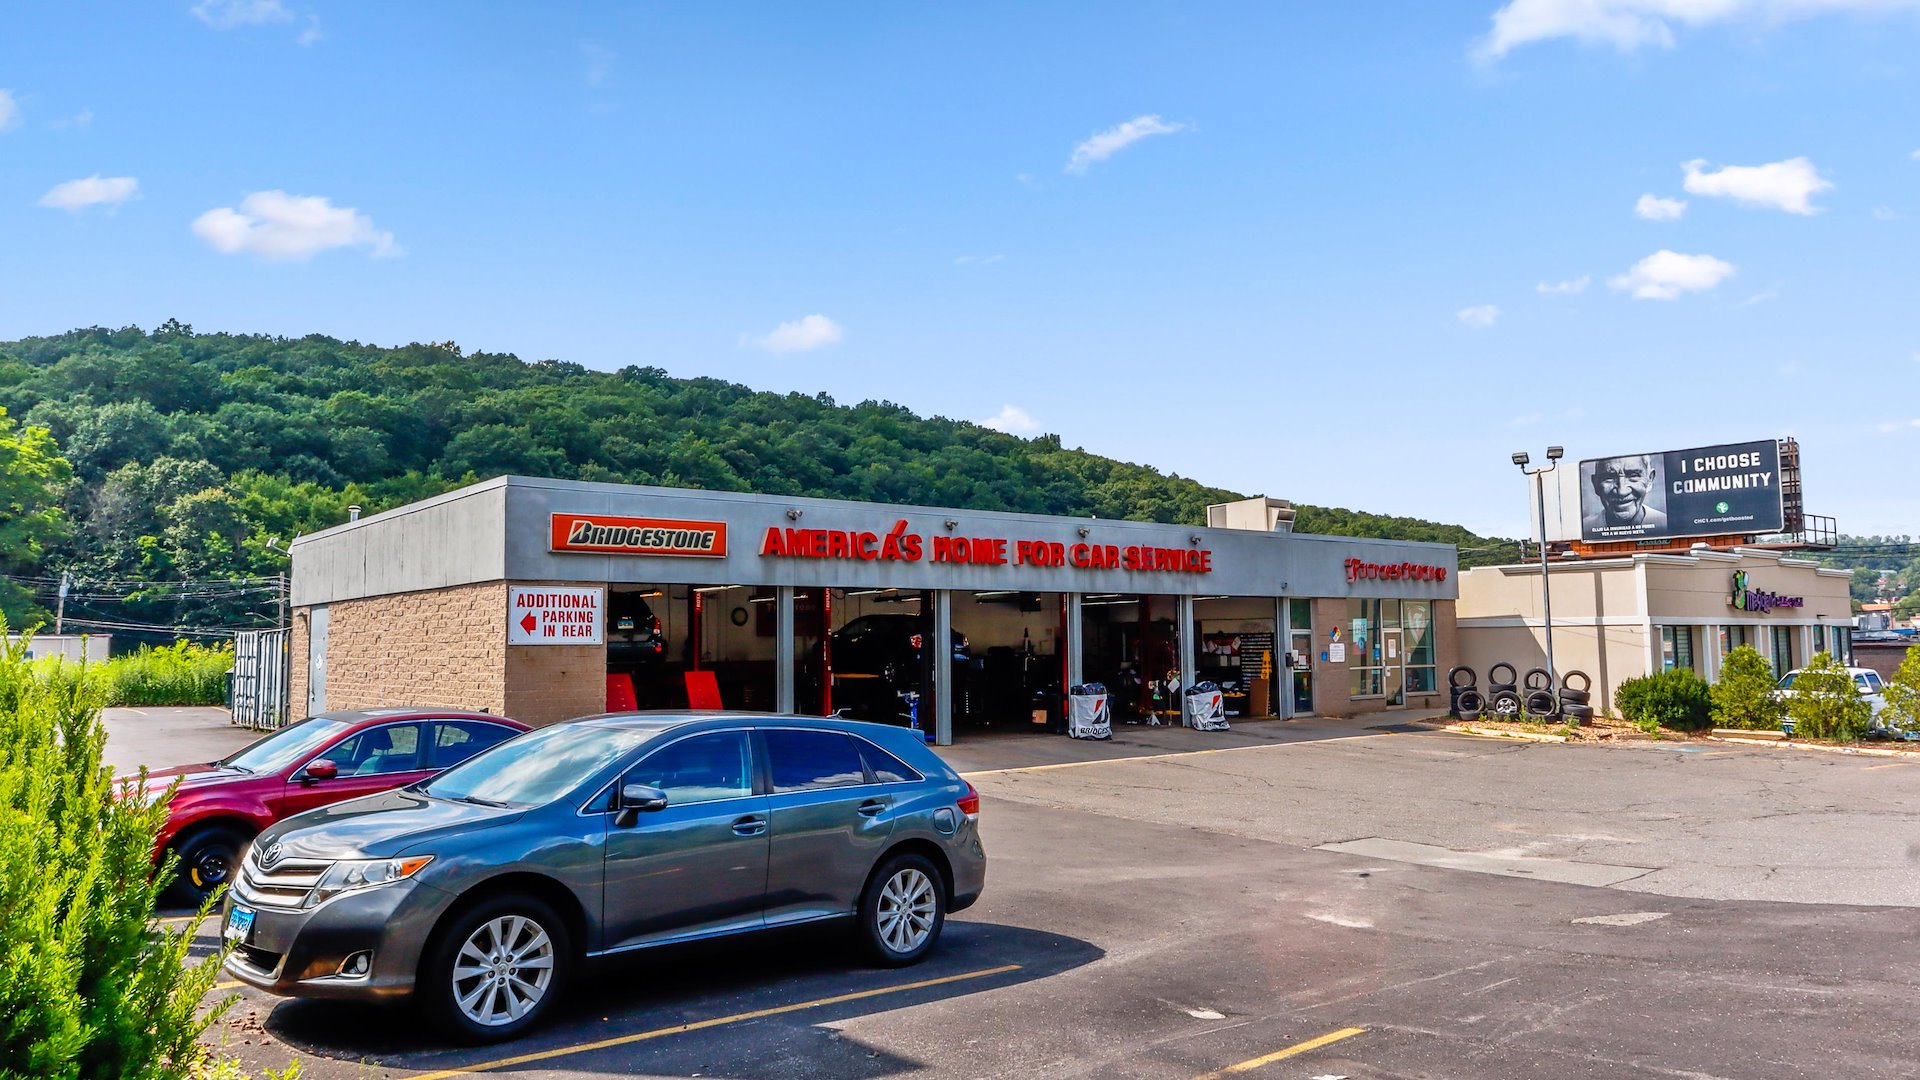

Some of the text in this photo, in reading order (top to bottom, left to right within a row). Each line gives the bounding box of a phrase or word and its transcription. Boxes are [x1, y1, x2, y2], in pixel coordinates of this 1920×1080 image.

[1681, 451, 1761, 473] I CHOOSE
[1672, 472, 1772, 494] COMMUNITY
[567, 520, 716, 550] BRIDGESTONE
[759, 519, 1213, 573] AMERICA'S HOME FOR CAR SERVICE
[1344, 557, 1447, 584] Firestone
[516, 593, 597, 609] ADDITIONAL
[542, 610, 593, 623] PARKING
[543, 625, 592, 637] IN REAR
